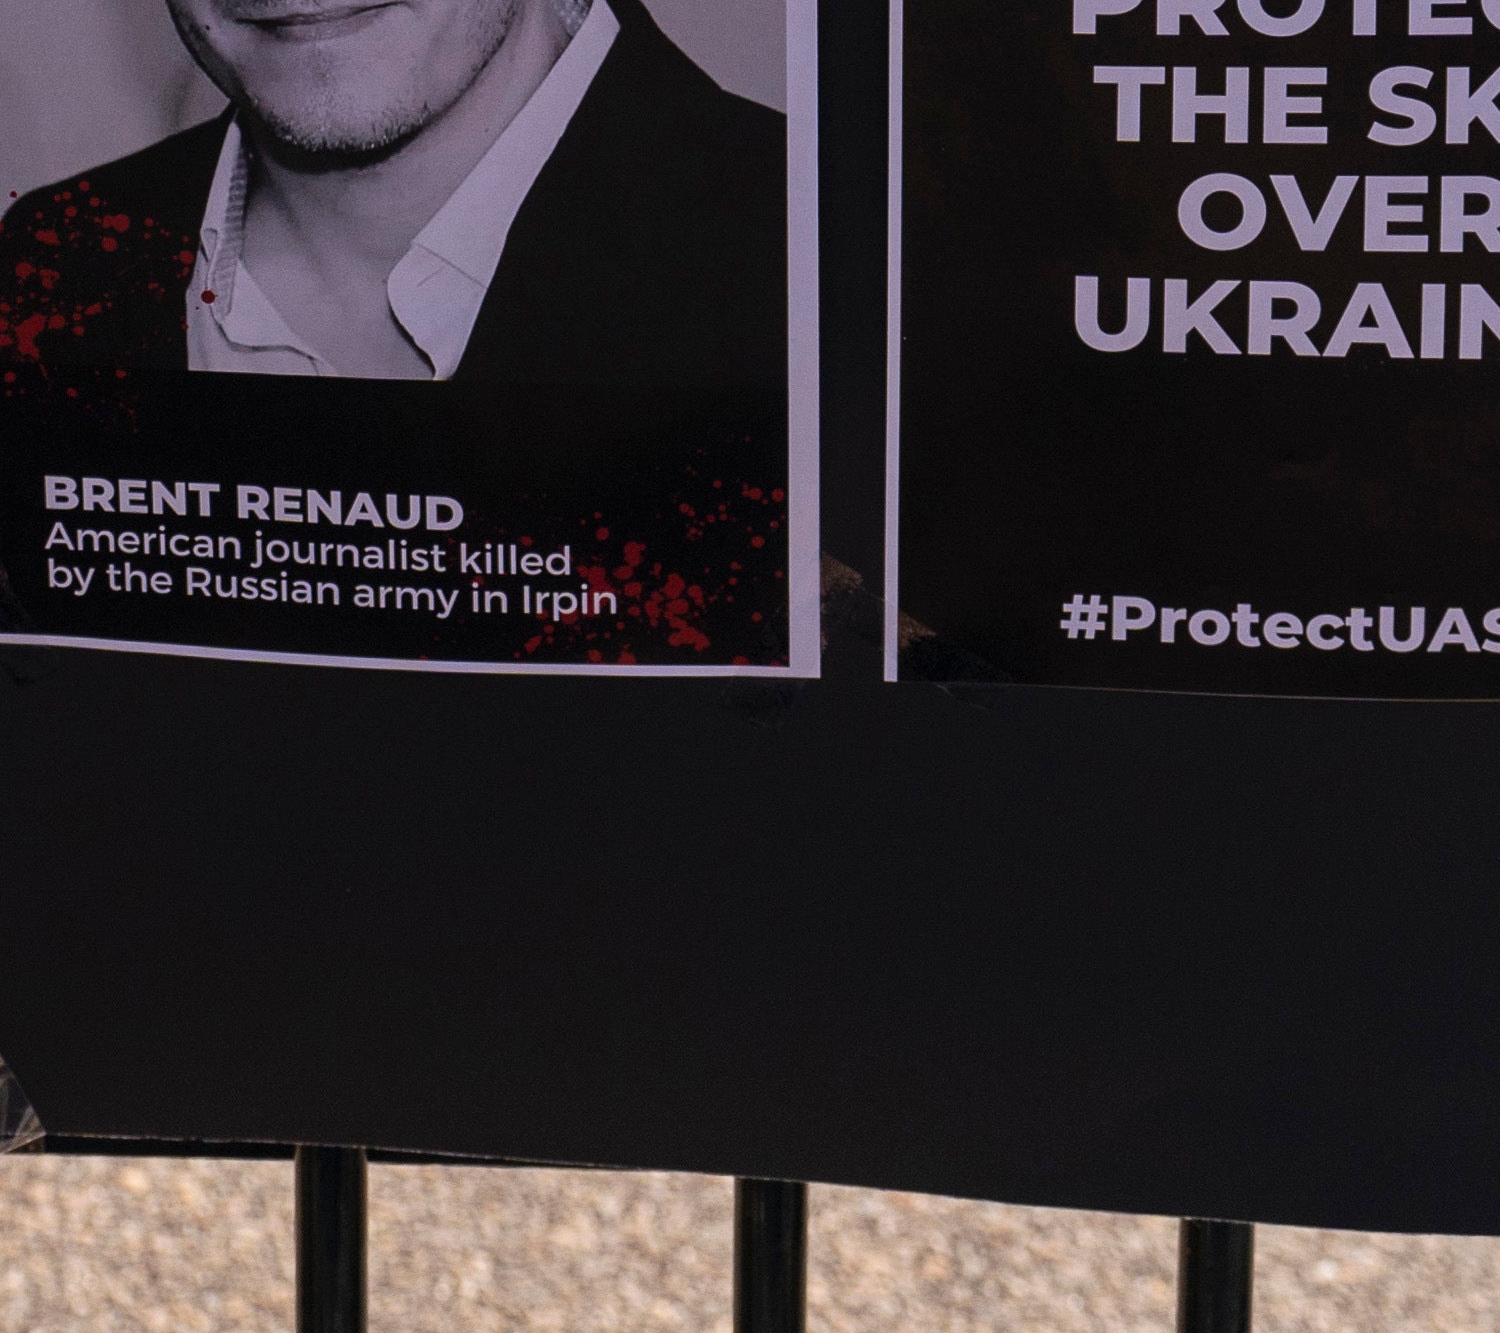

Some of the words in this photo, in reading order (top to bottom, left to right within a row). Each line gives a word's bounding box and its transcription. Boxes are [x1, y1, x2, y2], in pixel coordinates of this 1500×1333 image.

[1093, 65, 1328, 144] THE
[43, 475, 221, 517] BRENT
[236, 484, 465, 531] RENAUD
[44, 521, 242, 561] American
[251, 530, 447, 573] journalist
[459, 542, 571, 576] killed
[47, 557, 96, 597] by
[105, 562, 174, 595] the
[185, 566, 341, 607] Russian
[352, 582, 460, 619] army
[471, 582, 509, 615] in
[523, 583, 618, 622] Irpin
